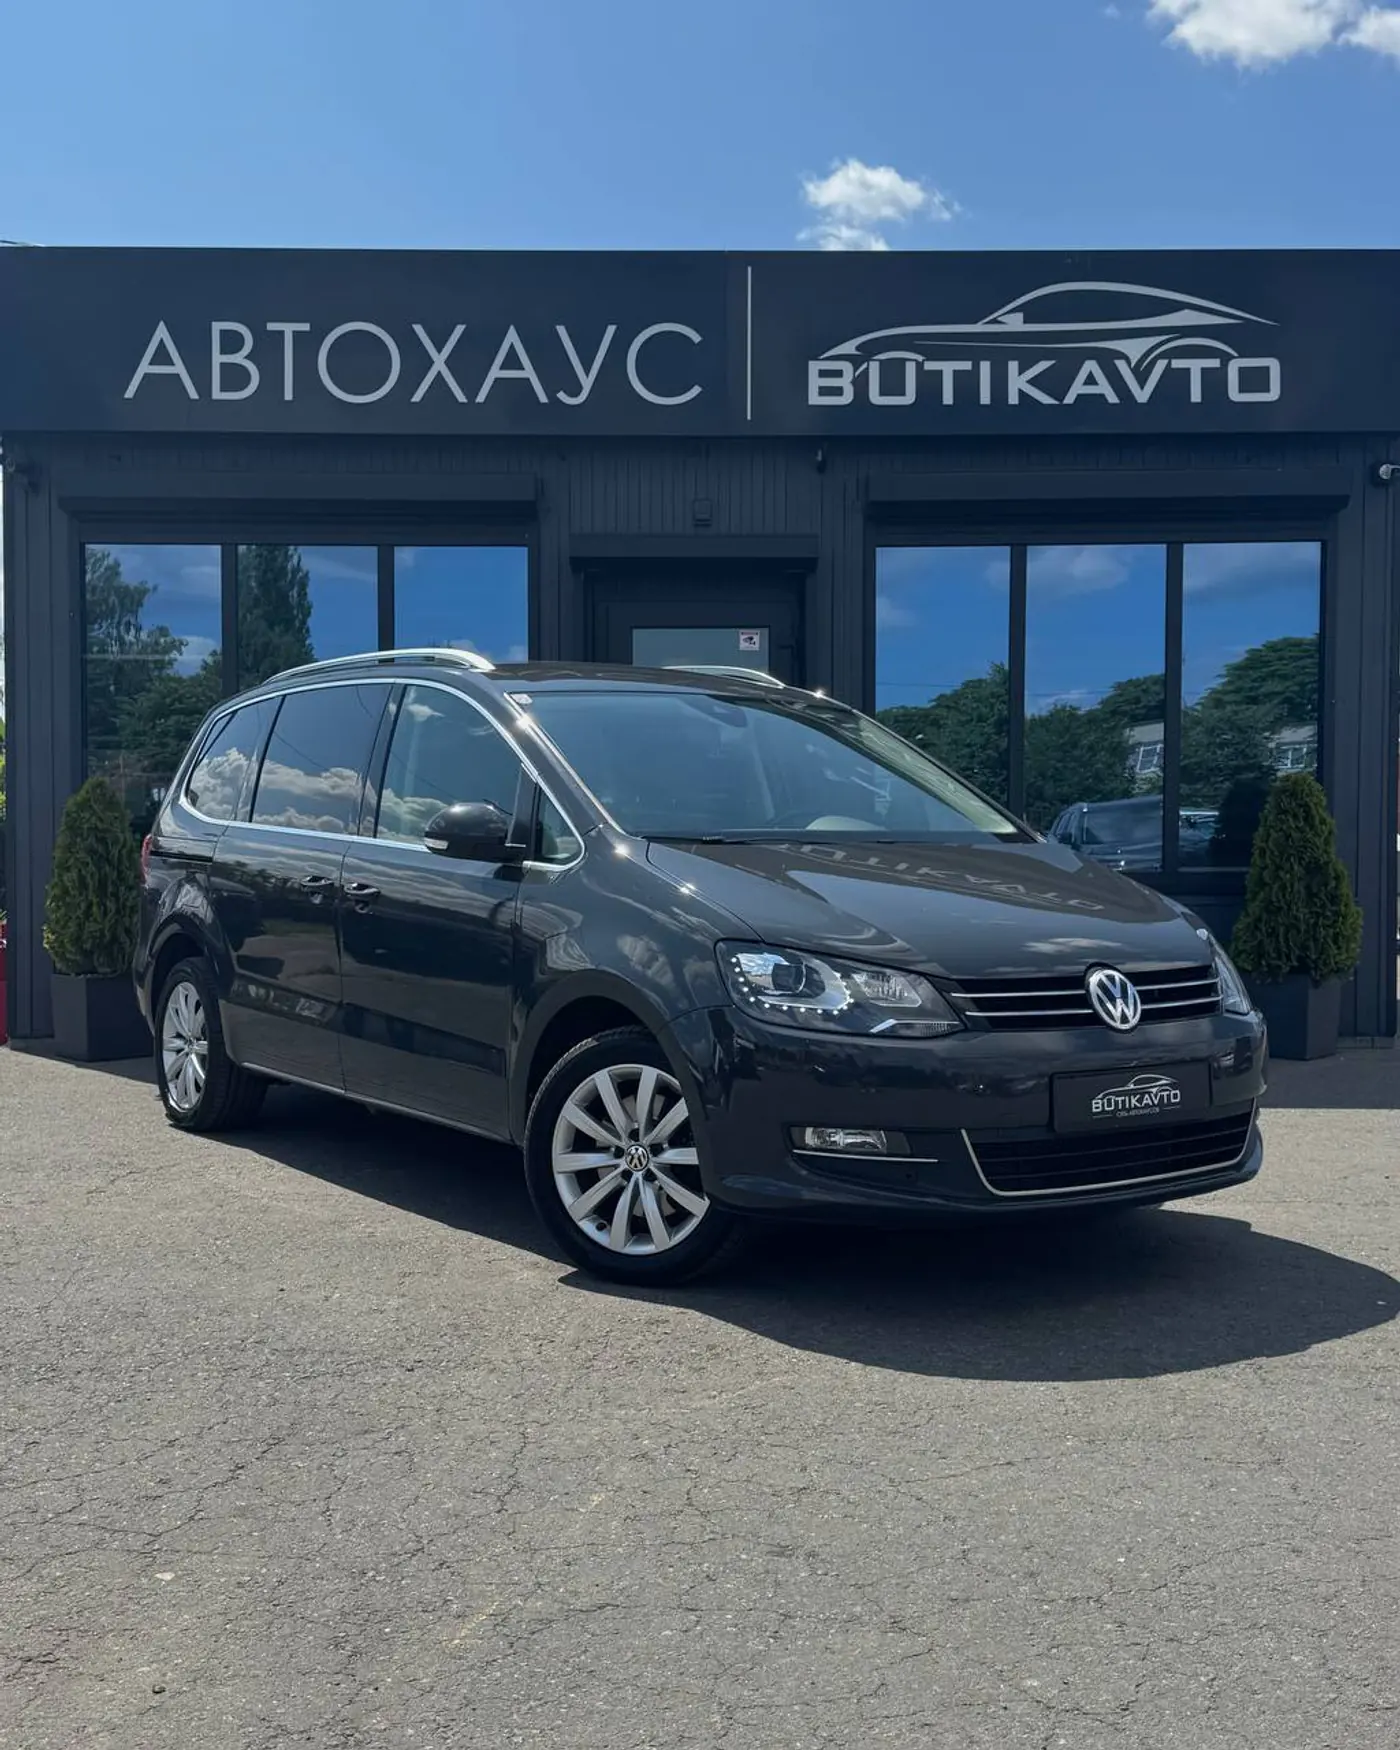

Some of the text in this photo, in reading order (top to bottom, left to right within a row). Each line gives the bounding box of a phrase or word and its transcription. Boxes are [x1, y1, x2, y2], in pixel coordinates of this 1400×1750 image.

[123, 320, 702, 405] АВТОХАУС
[807, 355, 1281, 406] BUTIKAVTO
[1092, 1090, 1181, 1113] BUTIKAVTO
